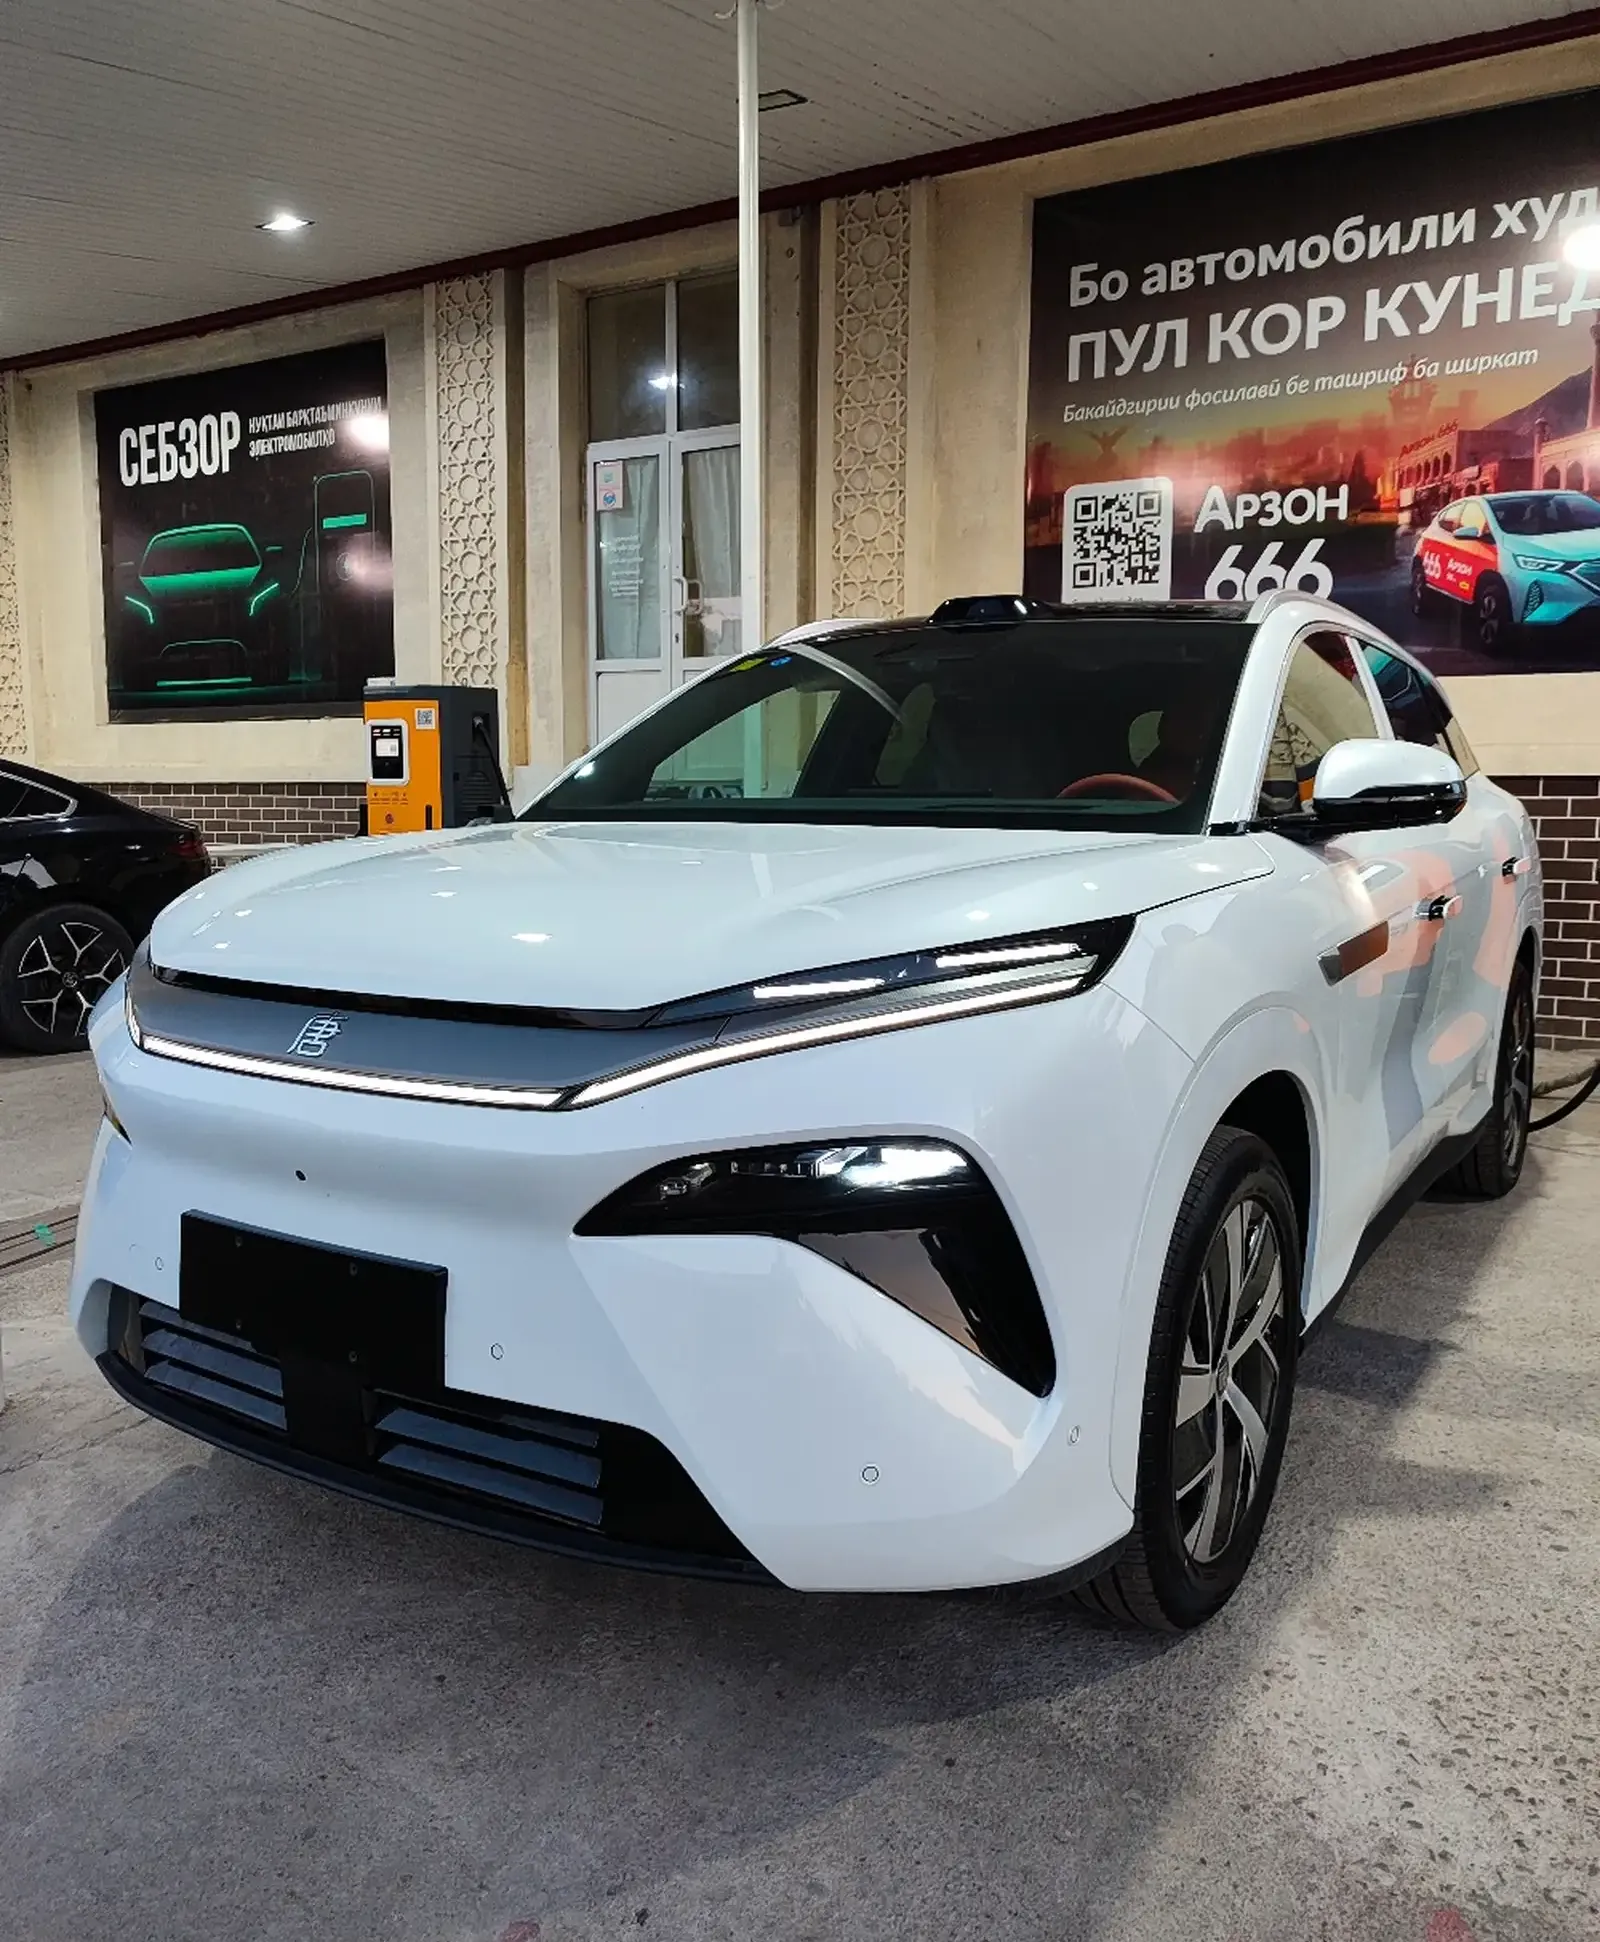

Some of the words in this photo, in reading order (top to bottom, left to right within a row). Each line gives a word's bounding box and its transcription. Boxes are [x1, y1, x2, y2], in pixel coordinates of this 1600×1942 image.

[1069, 262, 1129, 308] Бо
[1141, 208, 1476, 296] автомобили
[1068, 317, 1189, 383] ПУЛ
[1207, 295, 1346, 363] КОР
[1063, 394, 1180, 423] Бакайдгирии
[1286, 373, 1309, 395] бе
[1314, 360, 1408, 392] ташриф
[1413, 356, 1440, 379] ба
[1445, 348, 1539, 375] ширкат
[119, 410, 241, 488] СЕБЗОР
[1204, 538, 1335, 601] 666
